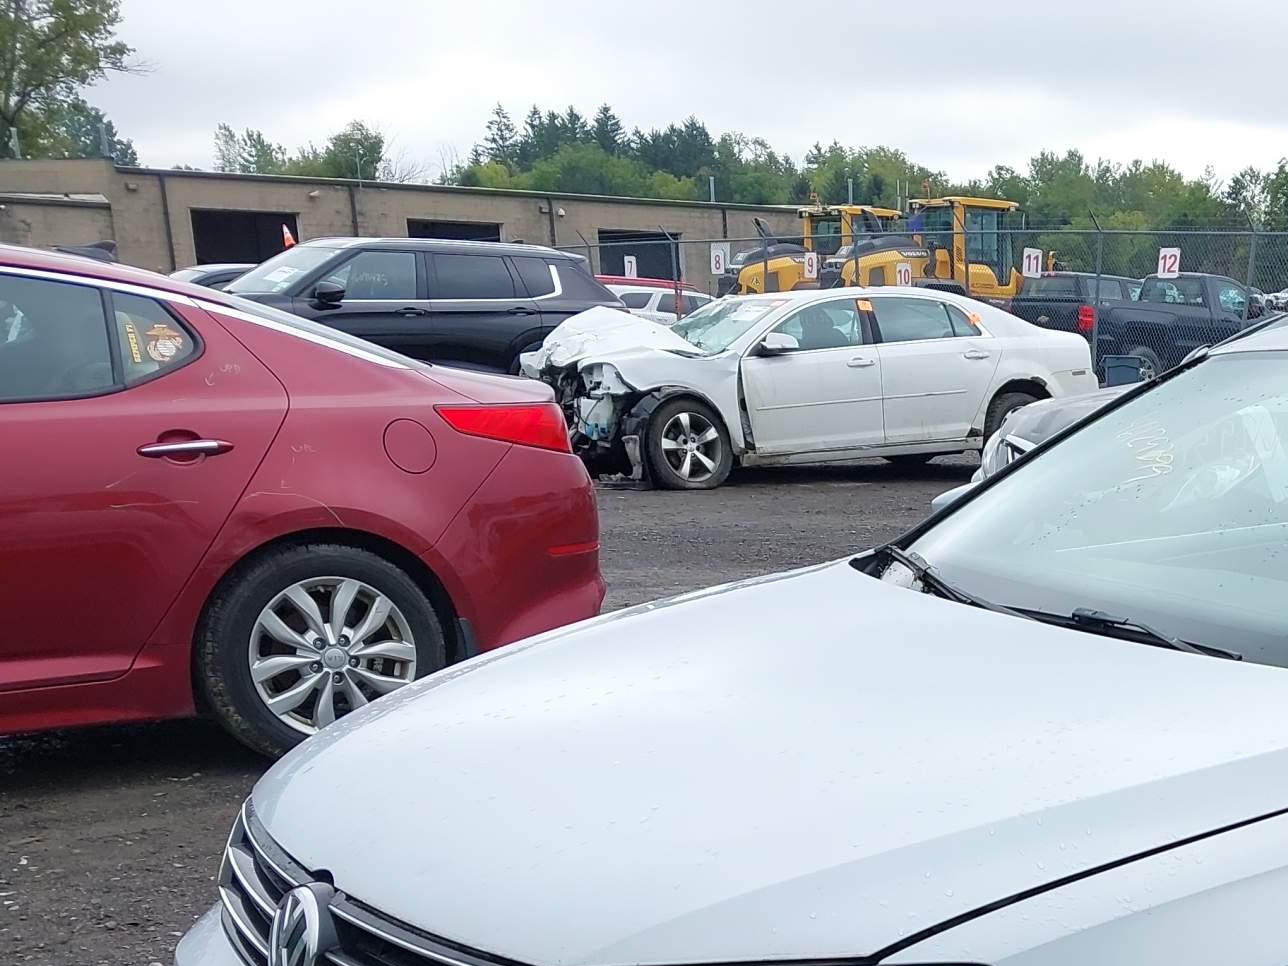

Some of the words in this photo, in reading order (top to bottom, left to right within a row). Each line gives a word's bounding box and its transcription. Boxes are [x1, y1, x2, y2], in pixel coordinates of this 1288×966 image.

[626, 260, 633, 275] 7
[714, 254, 721, 270] 8
[807, 256, 814, 274] 9
[1025, 254, 1040, 273] 11
[1160, 254, 1178, 274] 12
[898, 268, 910, 285] 10
